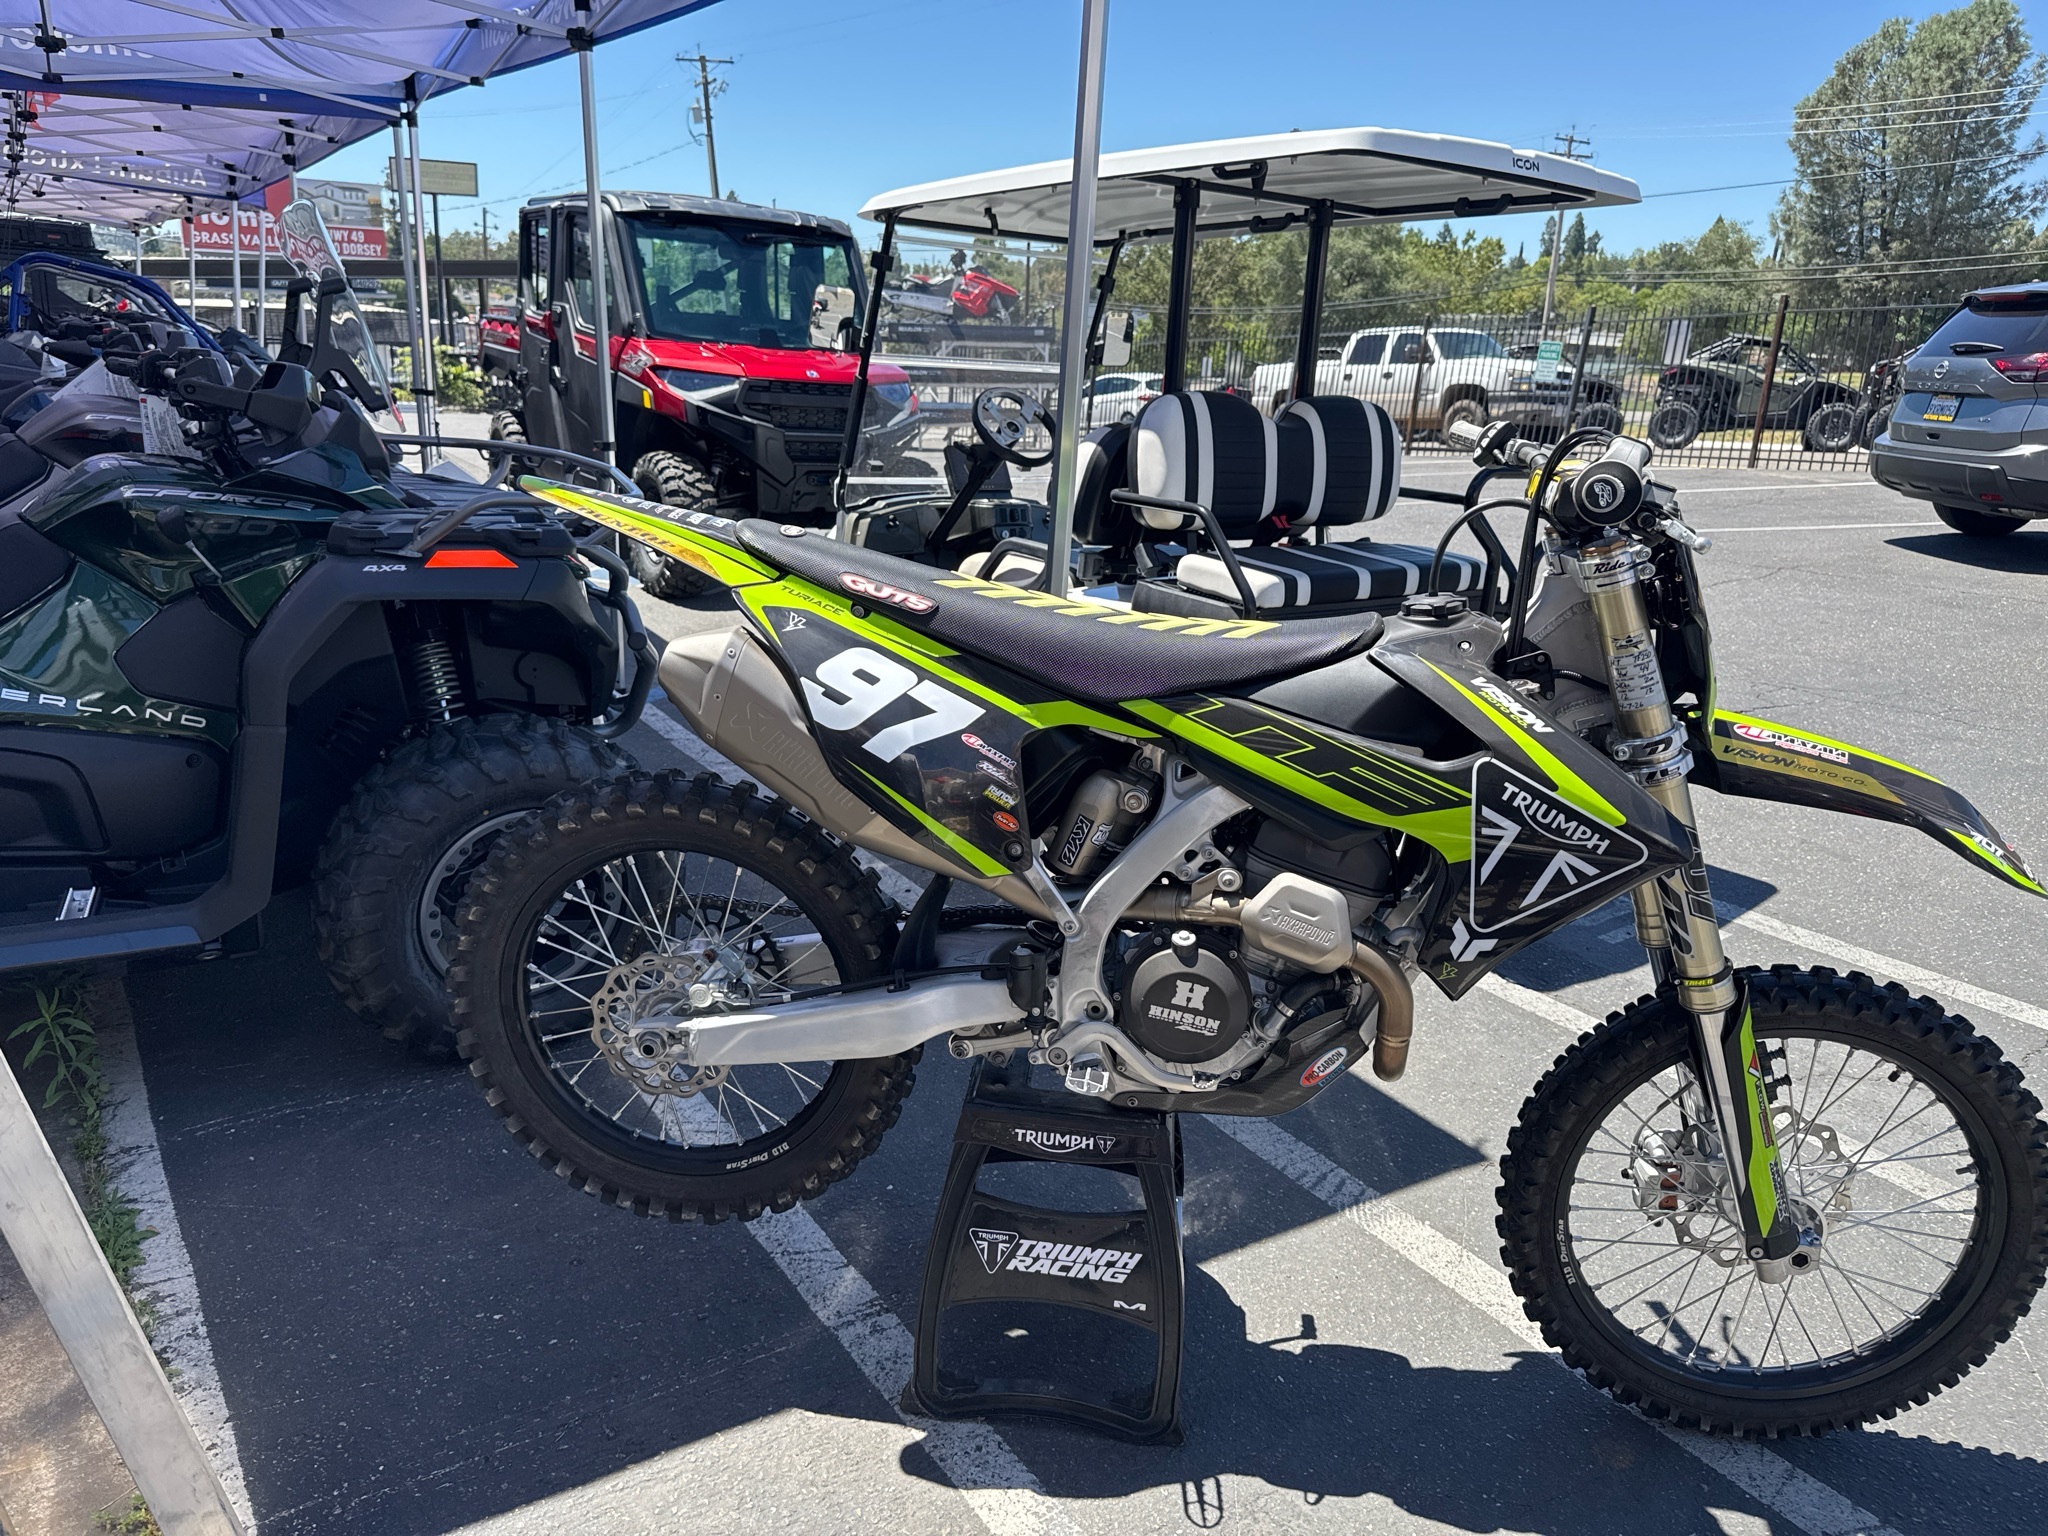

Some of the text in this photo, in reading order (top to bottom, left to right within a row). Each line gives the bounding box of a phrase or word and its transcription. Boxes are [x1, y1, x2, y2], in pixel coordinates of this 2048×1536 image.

[1512, 157, 1540, 172] ICON
[342, 243, 382, 257] DORSEY
[350, 230, 365, 243] 49
[124, 487, 314, 512] CFORCE
[362, 563, 408, 574] 4X4
[780, 585, 846, 616] TURIACE
[843, 574, 934, 612] GUTS
[800, 646, 986, 763] 97
[1470, 676, 1555, 732] VISION
[1478, 691, 1511, 714] MOTO
[1722, 744, 1868, 787] VISION MOTO CO.
[1501, 781, 1611, 855] TRIUMPH
[1171, 979, 1210, 1011] H
[1148, 1004, 1221, 1030] HINSON
[1304, 1050, 1344, 1084] PRO-CARBON
[1015, 1128, 1094, 1152] TRIUMPH
[978, 1232, 1009, 1242] TRIUMPH
[1015, 1238, 1143, 1270] TRIUMPH
[1005, 1256, 1132, 1284] RACING
